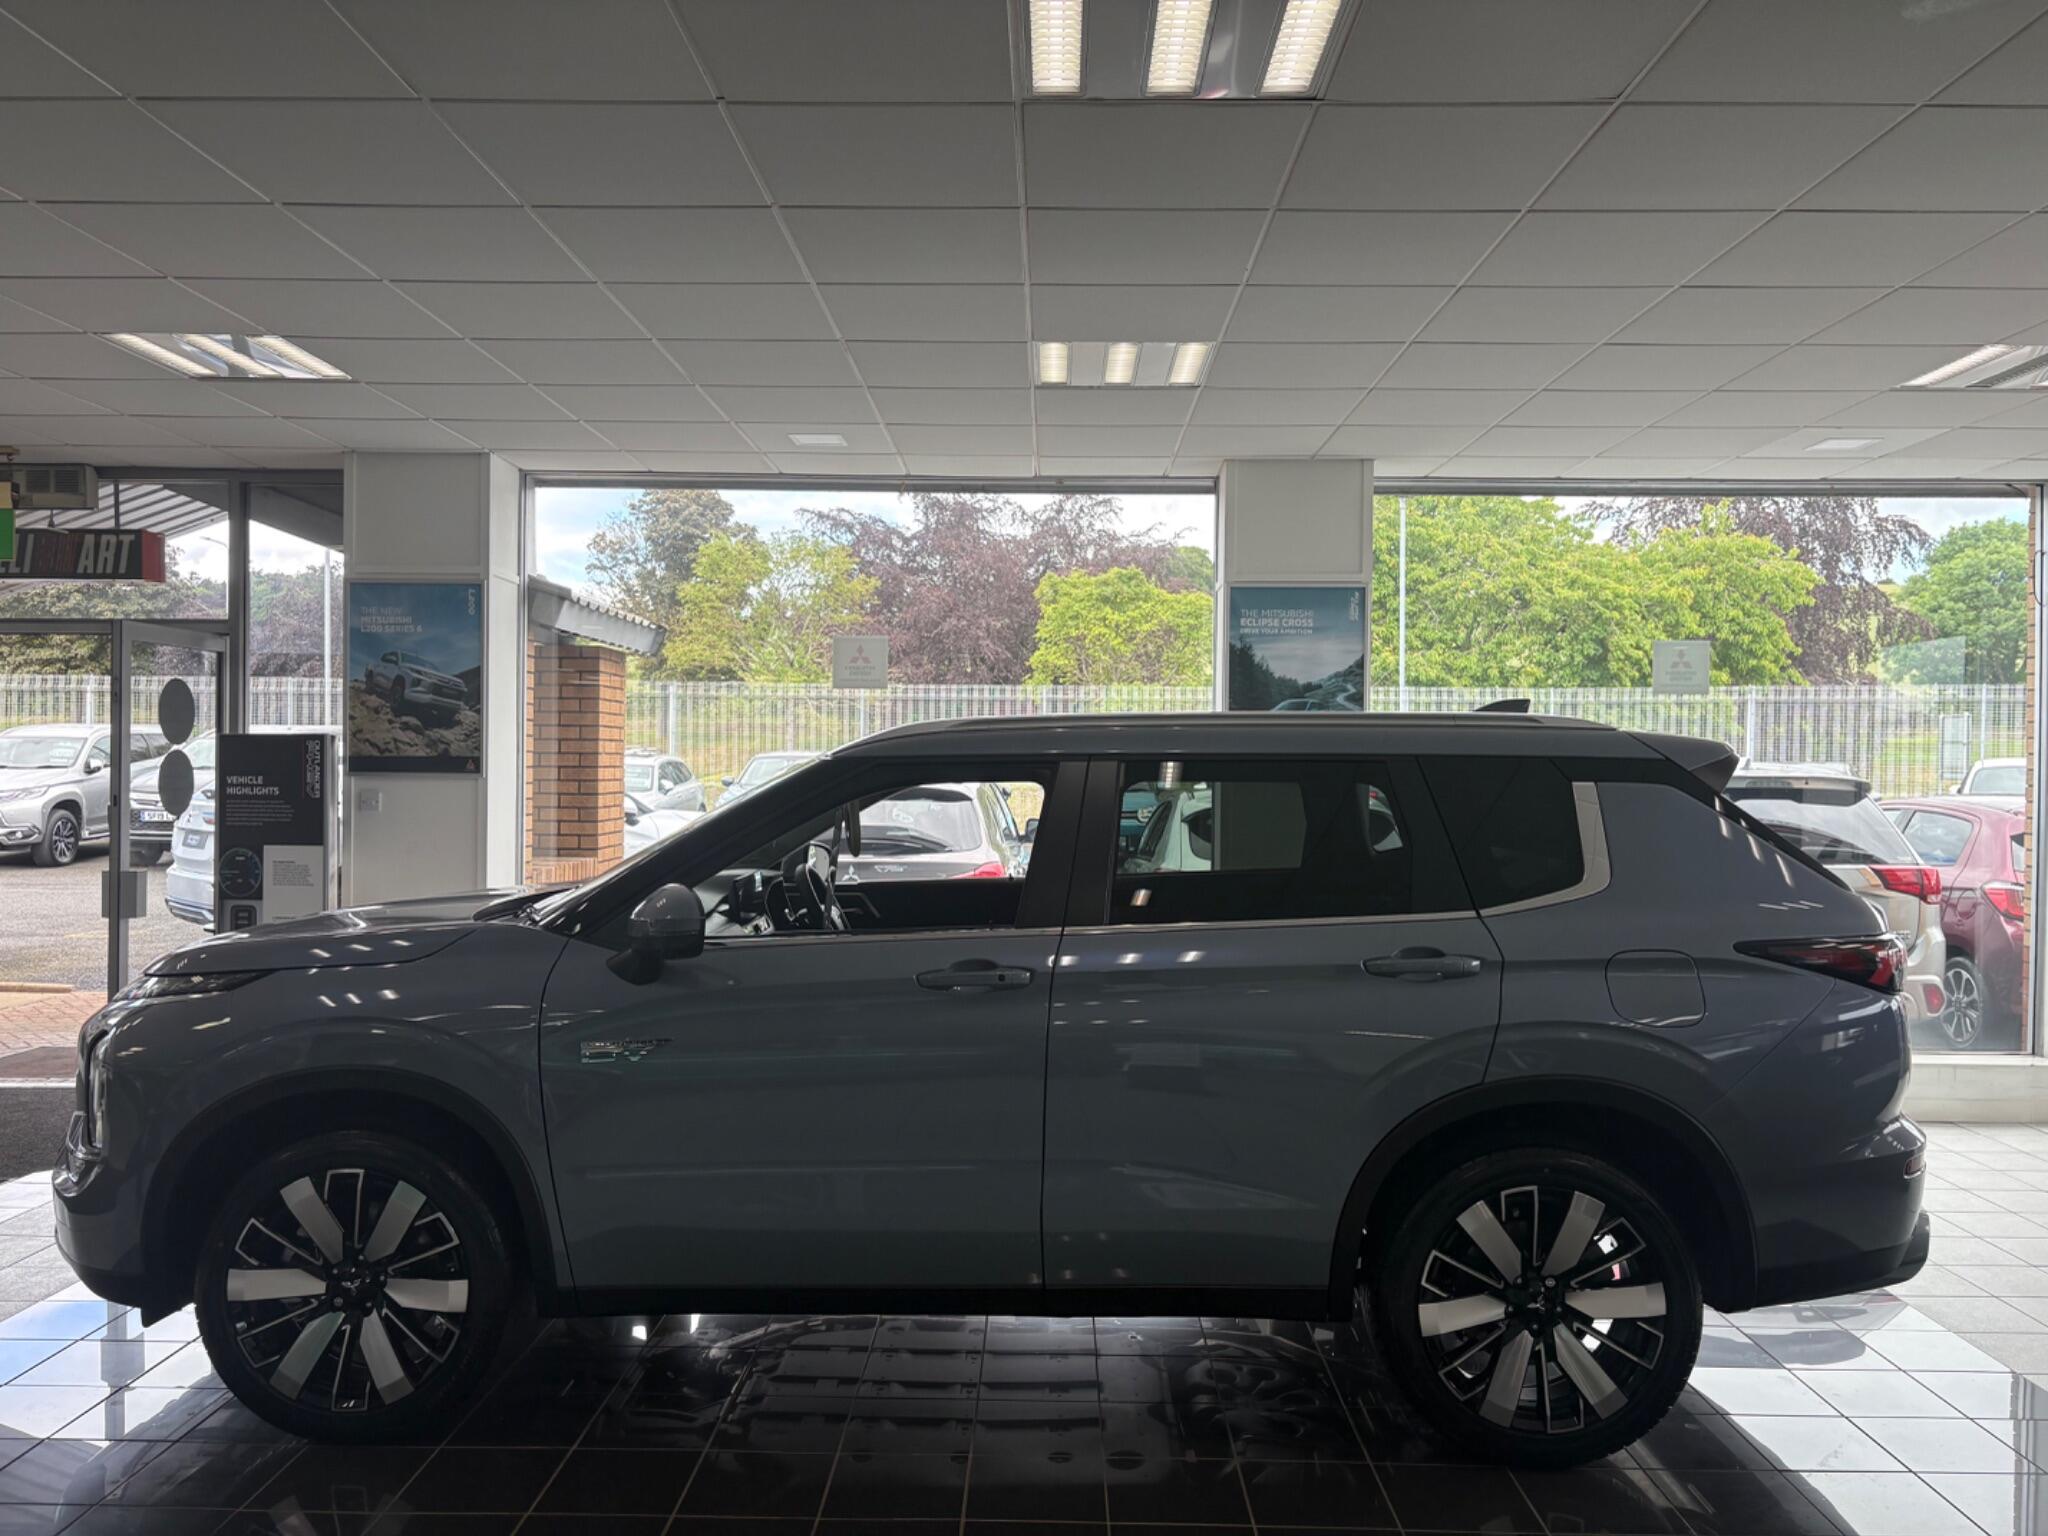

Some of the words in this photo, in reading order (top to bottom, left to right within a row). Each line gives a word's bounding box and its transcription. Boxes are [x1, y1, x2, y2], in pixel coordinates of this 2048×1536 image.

[1240, 609, 1259, 618] THE
[1261, 609, 1315, 618] MITSUBISHI
[361, 616, 412, 624] MITSUBISHI
[1240, 618, 1280, 627] ECLIPSE
[1282, 618, 1314, 627] CROSS
[384, 624, 415, 633] SERIES
[226, 775, 264, 785] VEHICLE
[226, 786, 280, 796] HIGHLIGHTS
